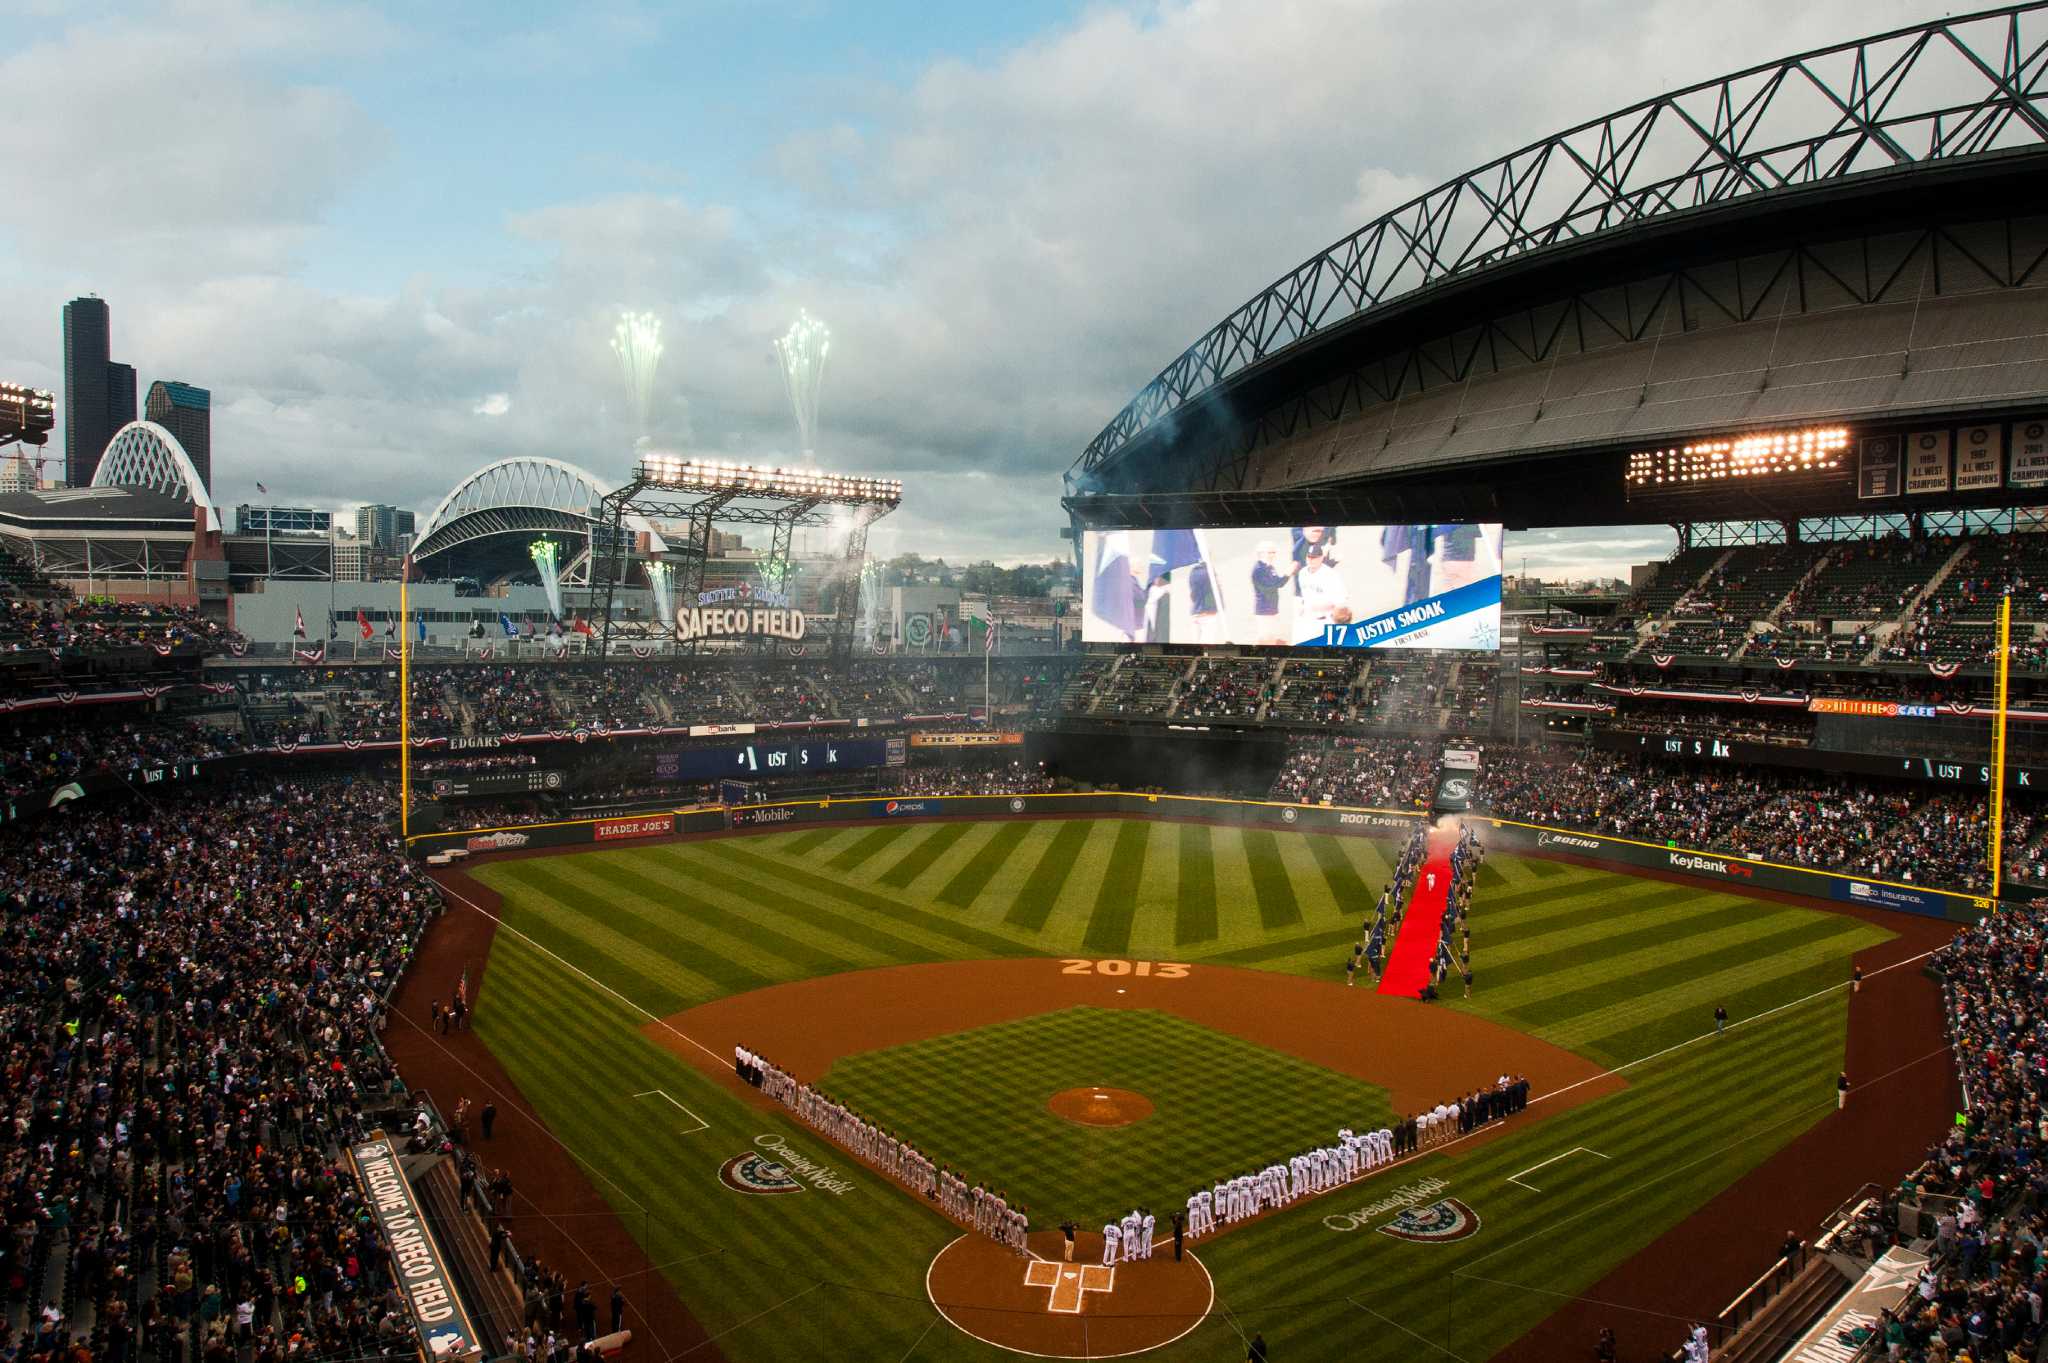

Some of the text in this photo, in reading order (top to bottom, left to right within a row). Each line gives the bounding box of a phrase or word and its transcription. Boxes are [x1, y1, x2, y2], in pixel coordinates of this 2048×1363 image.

[1925, 466, 1943, 476] WEST
[1975, 461, 1994, 471] WEST
[1908, 478, 1946, 489] CHAMPIONS
[1958, 474, 1998, 486] CHAMPIONS
[676, 607, 805, 640] SAFECO FIELD
[1355, 601, 1446, 646] JUSTIN SMOAK
[1325, 625, 1348, 646] 17
[1394, 630, 1431, 647] FIRST BASE
[898, 801, 924, 812] pepsi
[600, 820, 670, 835] TRADER JOE'S
[1340, 813, 1410, 827] ROOT SPORTS
[1552, 835, 1600, 849] BOEING
[1669, 853, 1727, 873] KeyBank
[1852, 884, 1879, 896] Safeco
[1973, 899, 1990, 910] 326
[1059, 959, 1192, 978] 2013
[364, 1157, 410, 1213] WELCOME
[808, 1166, 857, 1196] Night
[1391, 1177, 1451, 1202] Night
[390, 1228, 436, 1278] SAFECO
[409, 1278, 454, 1323] FIELD
